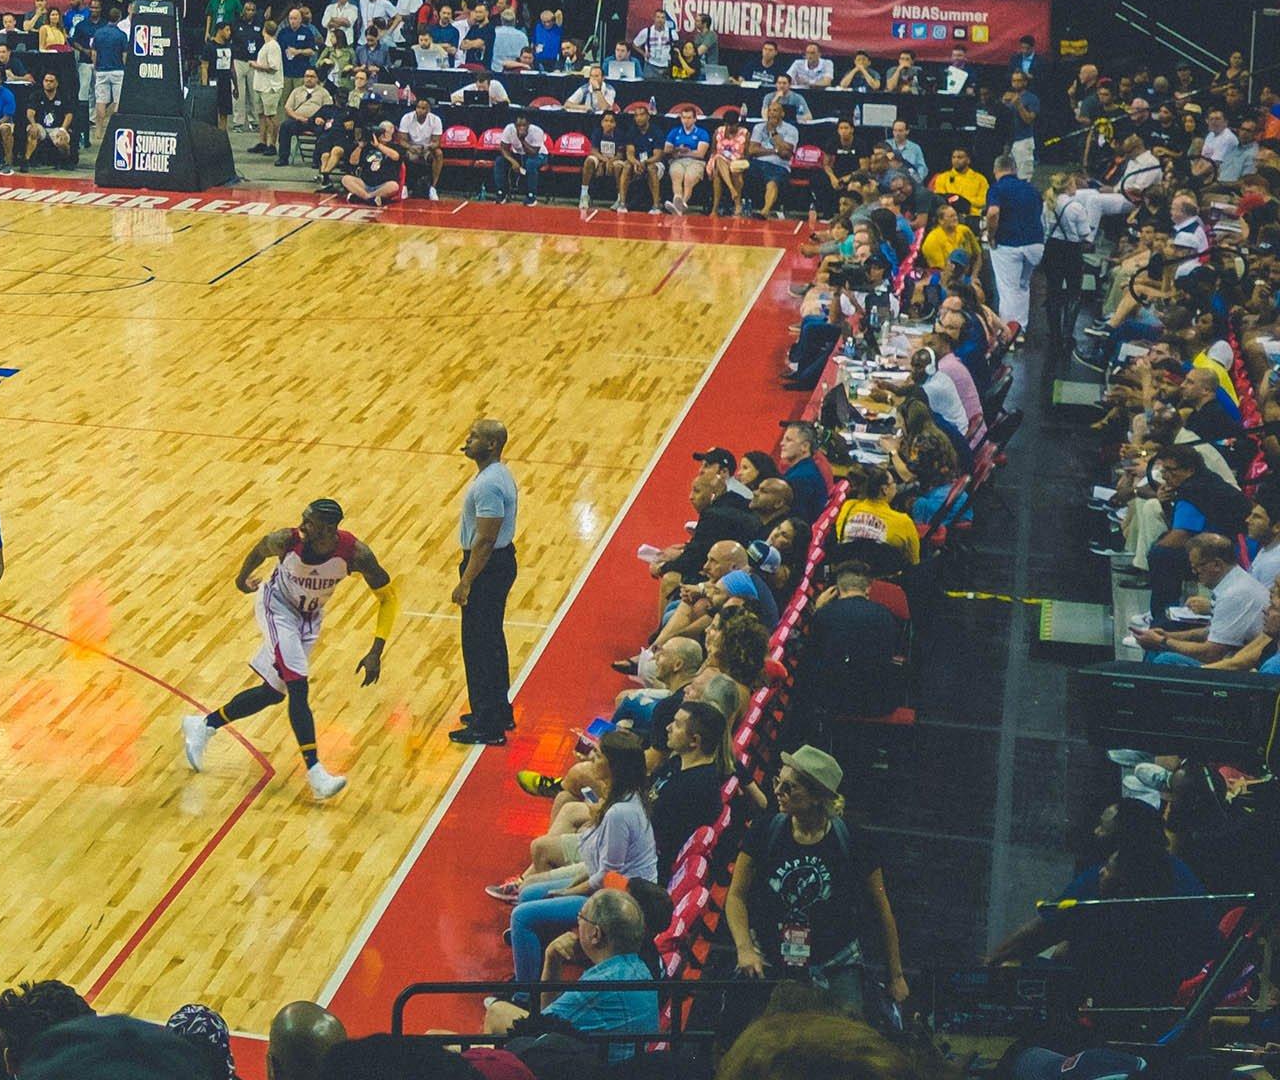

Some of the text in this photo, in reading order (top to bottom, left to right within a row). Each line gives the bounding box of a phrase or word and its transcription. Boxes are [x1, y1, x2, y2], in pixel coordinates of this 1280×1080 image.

[766, 3, 833, 40] LEAGUE
[892, 5, 989, 23] #NBASummer
[139, 63, 164, 80] @NBA
[135, 135, 177, 156] SUMMER
[134, 153, 170, 173] LEAGUE
[169, 198, 385, 222] LEAGUE
